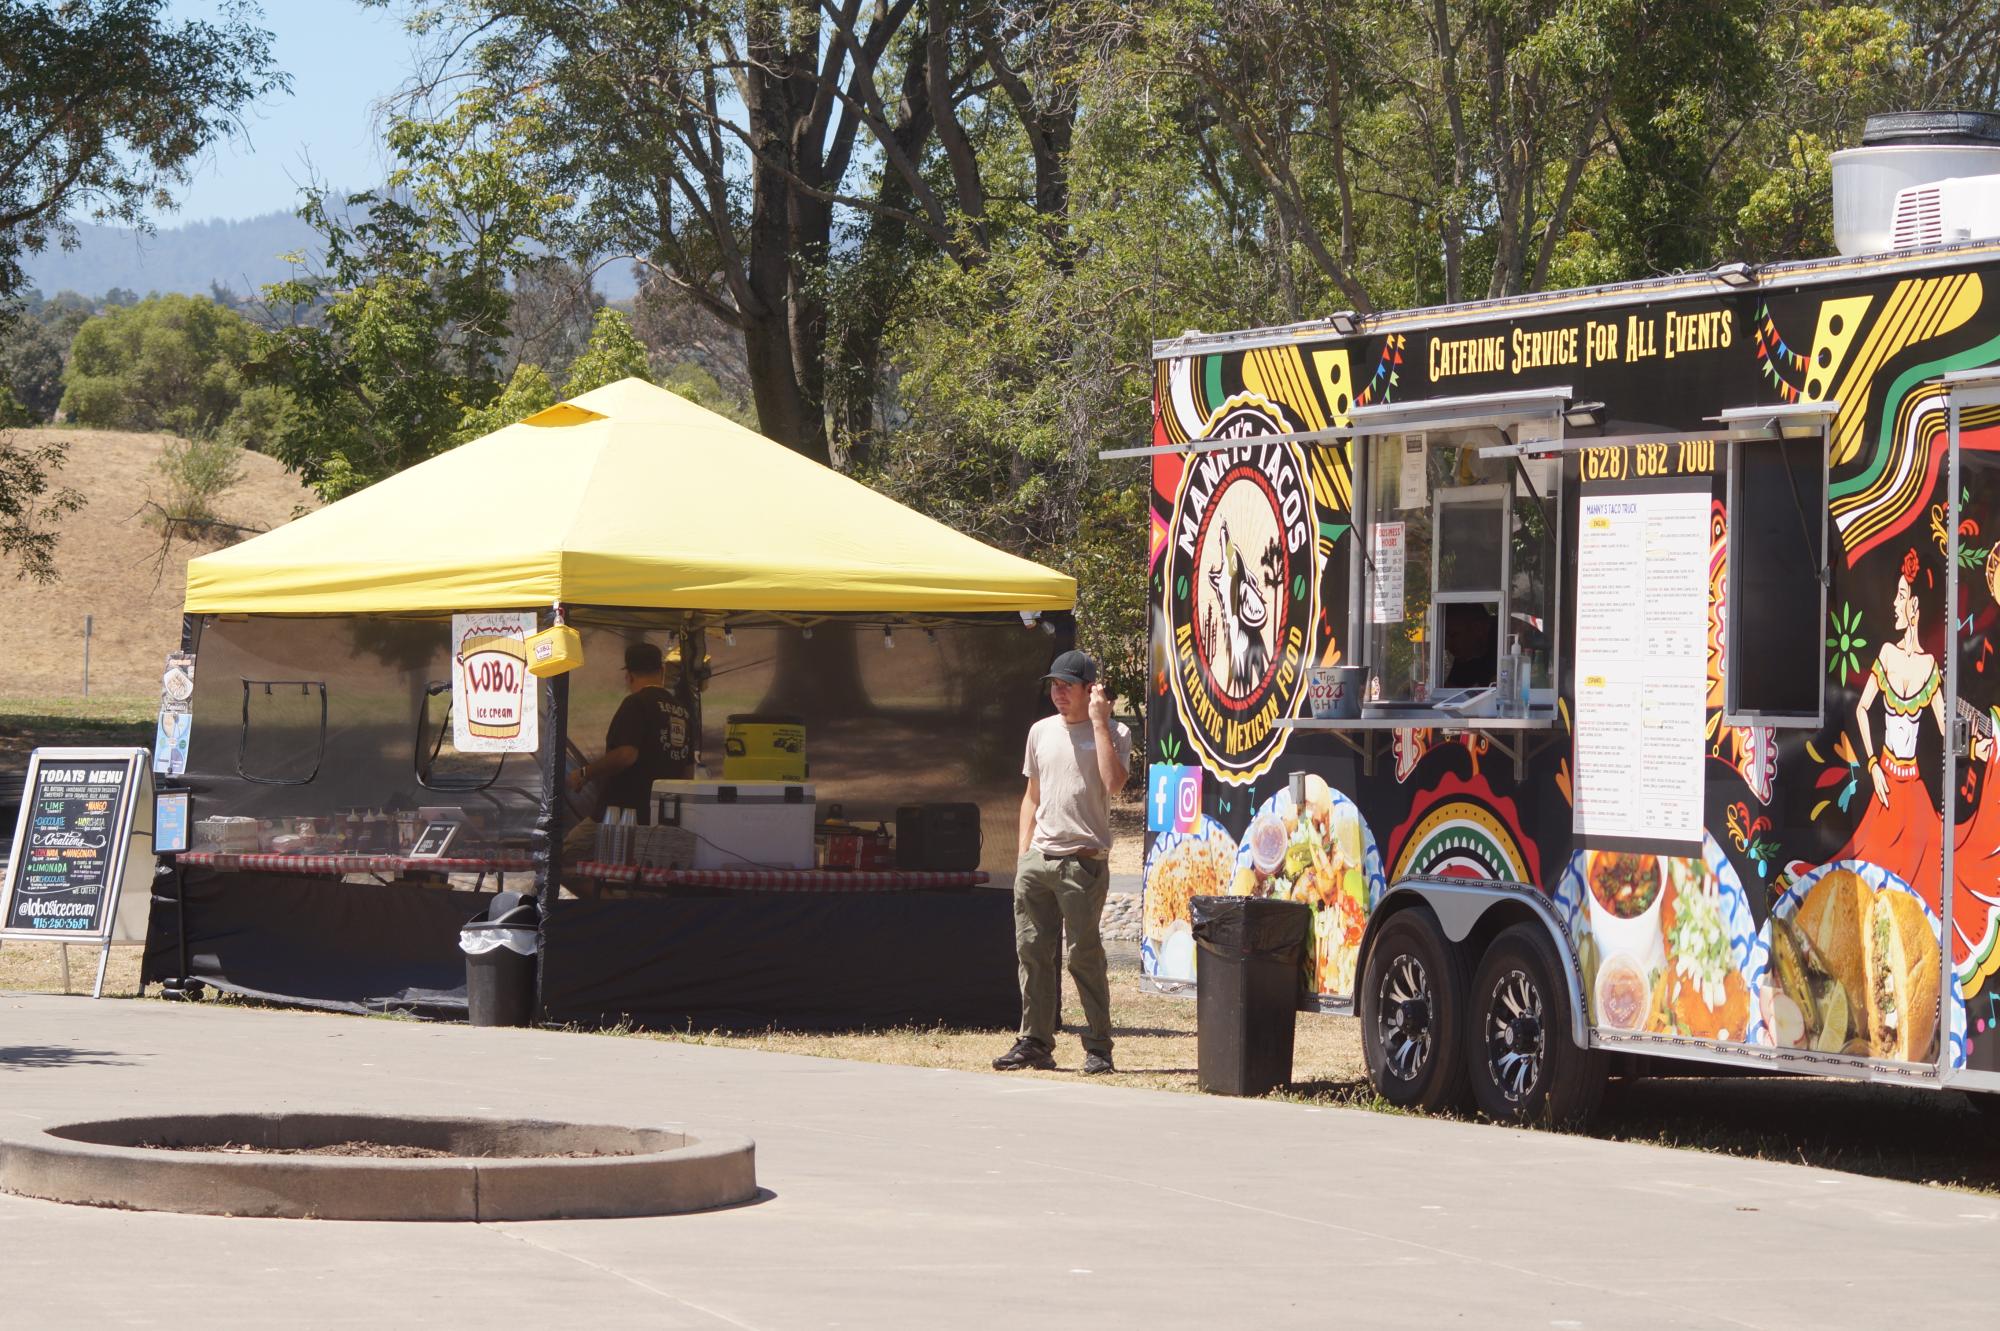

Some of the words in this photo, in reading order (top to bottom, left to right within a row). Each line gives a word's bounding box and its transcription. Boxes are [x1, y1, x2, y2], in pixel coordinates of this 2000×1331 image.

[1429, 336, 1505, 383] CATERING
[1512, 328, 1579, 374] SERVICE
[1586, 320, 1618, 368] FOR
[1625, 315, 1656, 362] ALL
[1665, 309, 1732, 359] EVENTS
[1579, 447, 1628, 482] (628)
[1636, 443, 1668, 476] 682
[1678, 440, 1715, 473] 7001
[1258, 427, 1307, 553] TACOS
[1317, 671, 1336, 685] Tips
[1176, 622, 1223, 743] AUTHENTIC
[1226, 692, 1279, 755] MEXICAN
[1276, 626, 1302, 701] FOOD
[476, 706, 488, 719] ice
[489, 707, 513, 719] cream
[88, 770, 124, 784] MENU
[45, 801, 65, 811] LIME
[32, 862, 67, 873] LIMONADA
[19, 897, 96, 917] @lobosicecream
